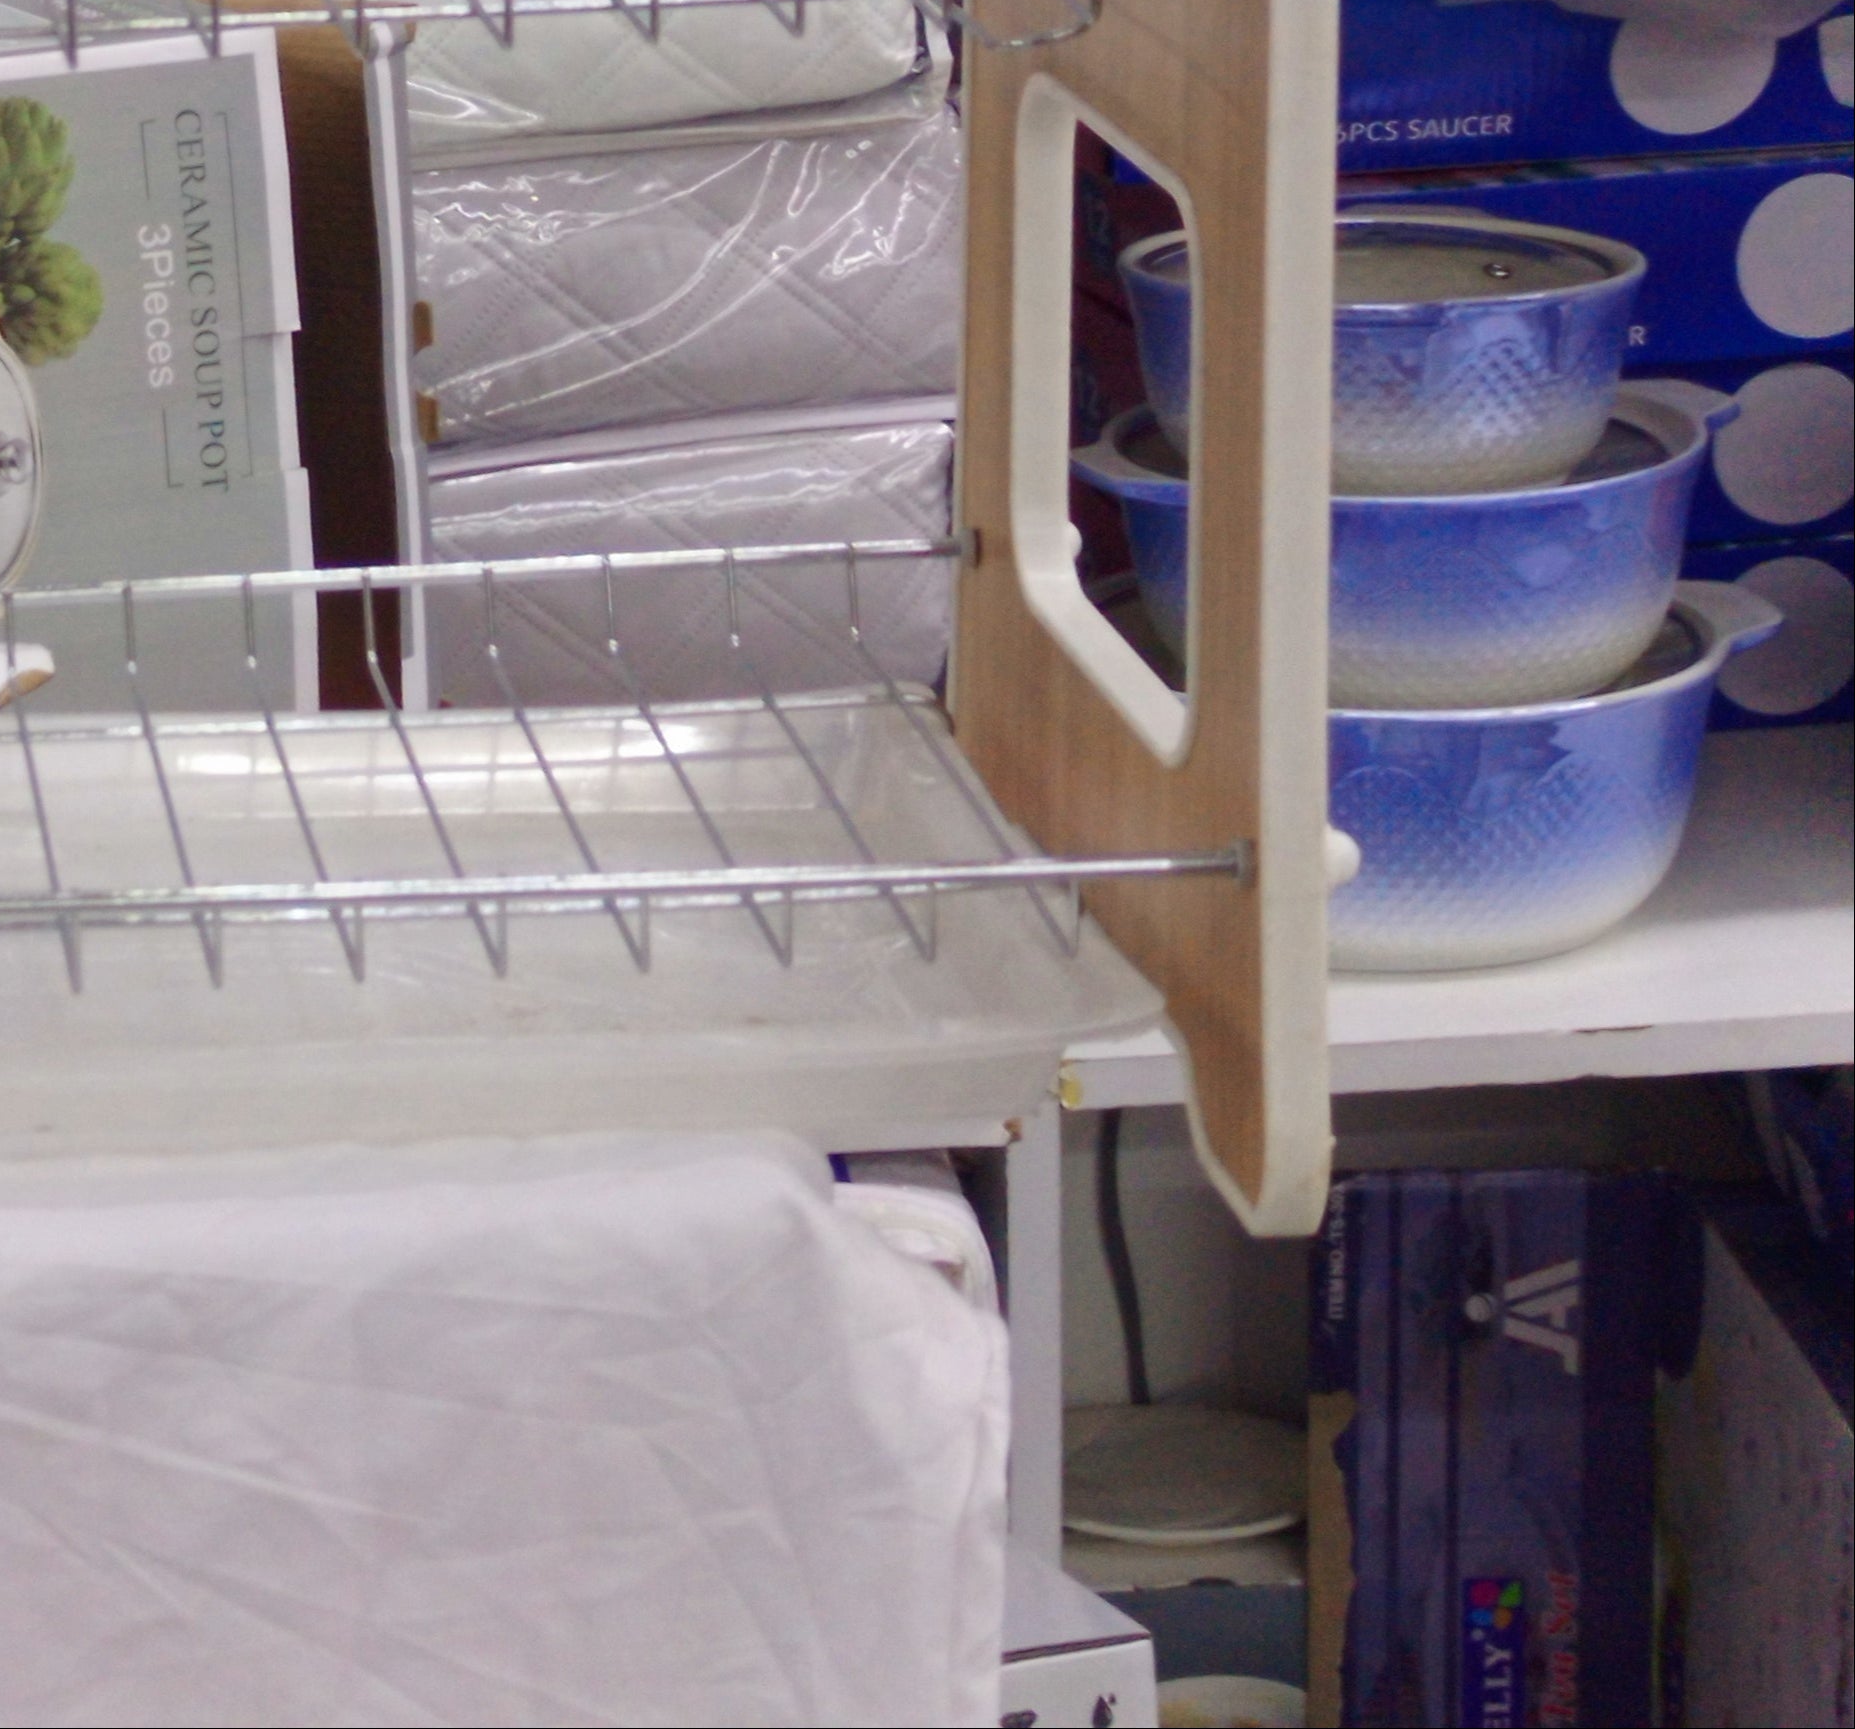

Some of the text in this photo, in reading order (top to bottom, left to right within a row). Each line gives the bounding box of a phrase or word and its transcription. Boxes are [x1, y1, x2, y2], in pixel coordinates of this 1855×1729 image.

[1407, 114, 1513, 140] SAUCER
[137, 223, 175, 389] 3Pieces
[174, 108, 229, 492] CERAMIC SOUP POT
